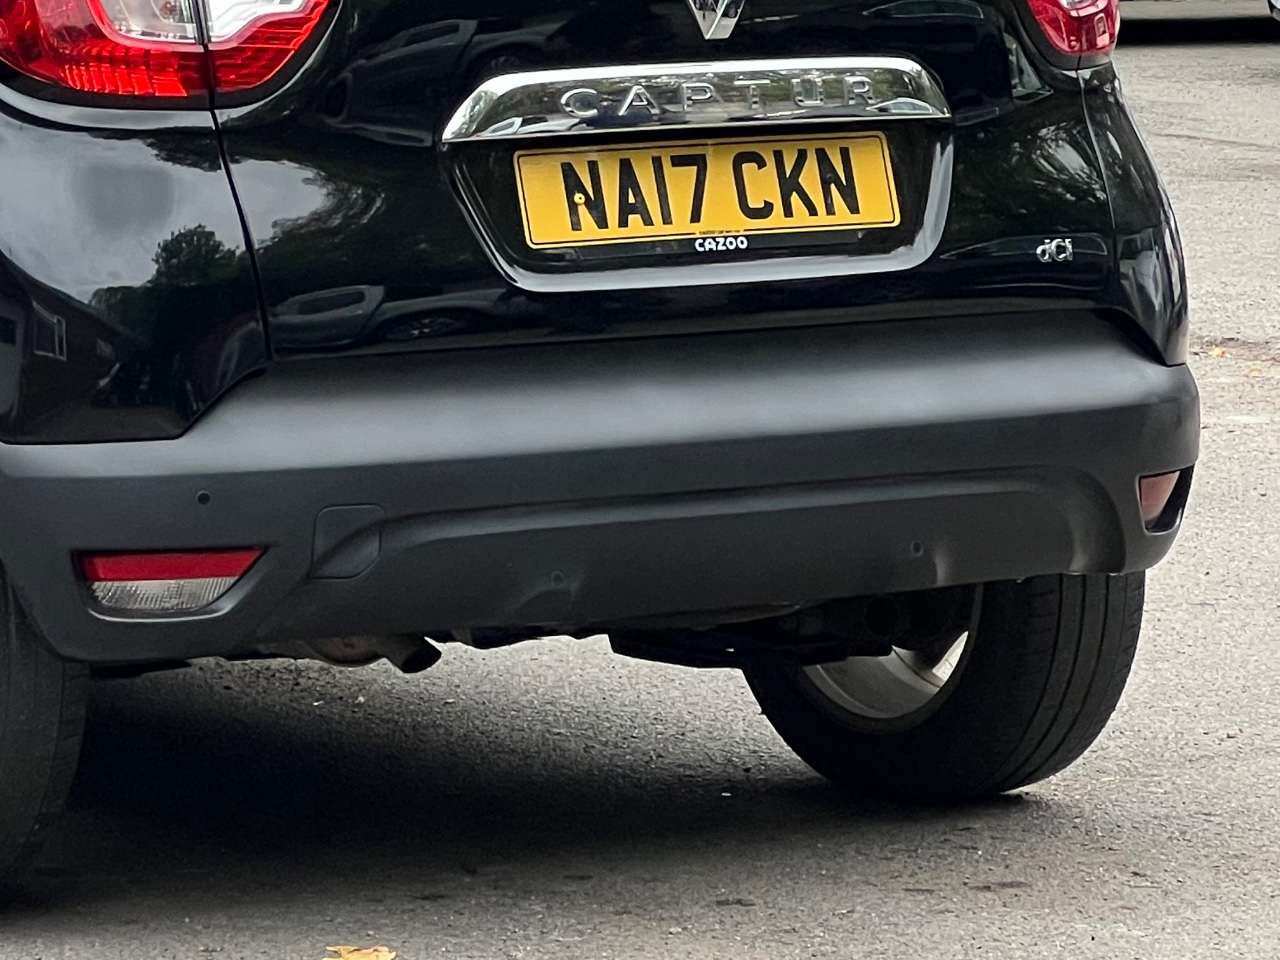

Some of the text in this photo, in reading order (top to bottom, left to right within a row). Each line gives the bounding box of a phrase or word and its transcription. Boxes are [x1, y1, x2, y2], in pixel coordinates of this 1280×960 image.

[560, 74, 878, 118] CAPTUR
[561, 146, 861, 232] NA17 CKN
[694, 236, 748, 252] CAZOO
